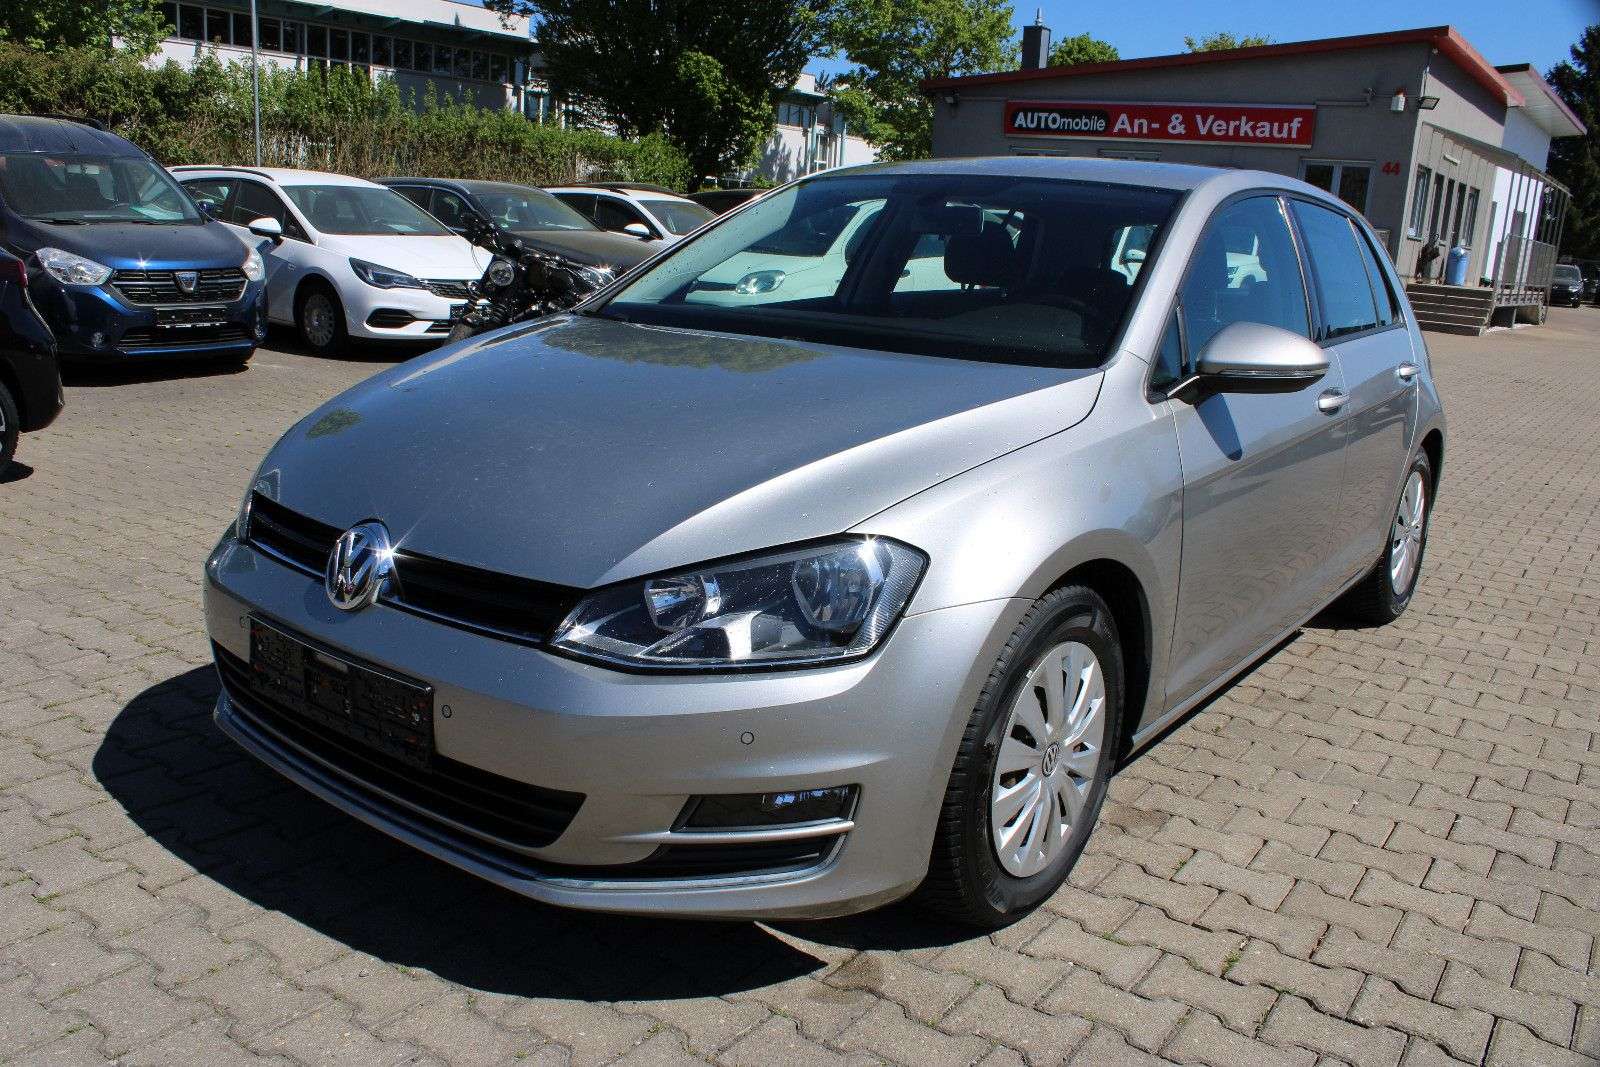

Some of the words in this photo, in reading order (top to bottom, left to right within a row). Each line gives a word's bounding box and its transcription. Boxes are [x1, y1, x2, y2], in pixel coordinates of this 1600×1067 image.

[1014, 111, 1106, 131] AUTOmobile
[1112, 113, 1160, 134] An-
[1167, 113, 1187, 135] &
[1195, 114, 1303, 139] Verkauf
[1381, 160, 1401, 176] 44
